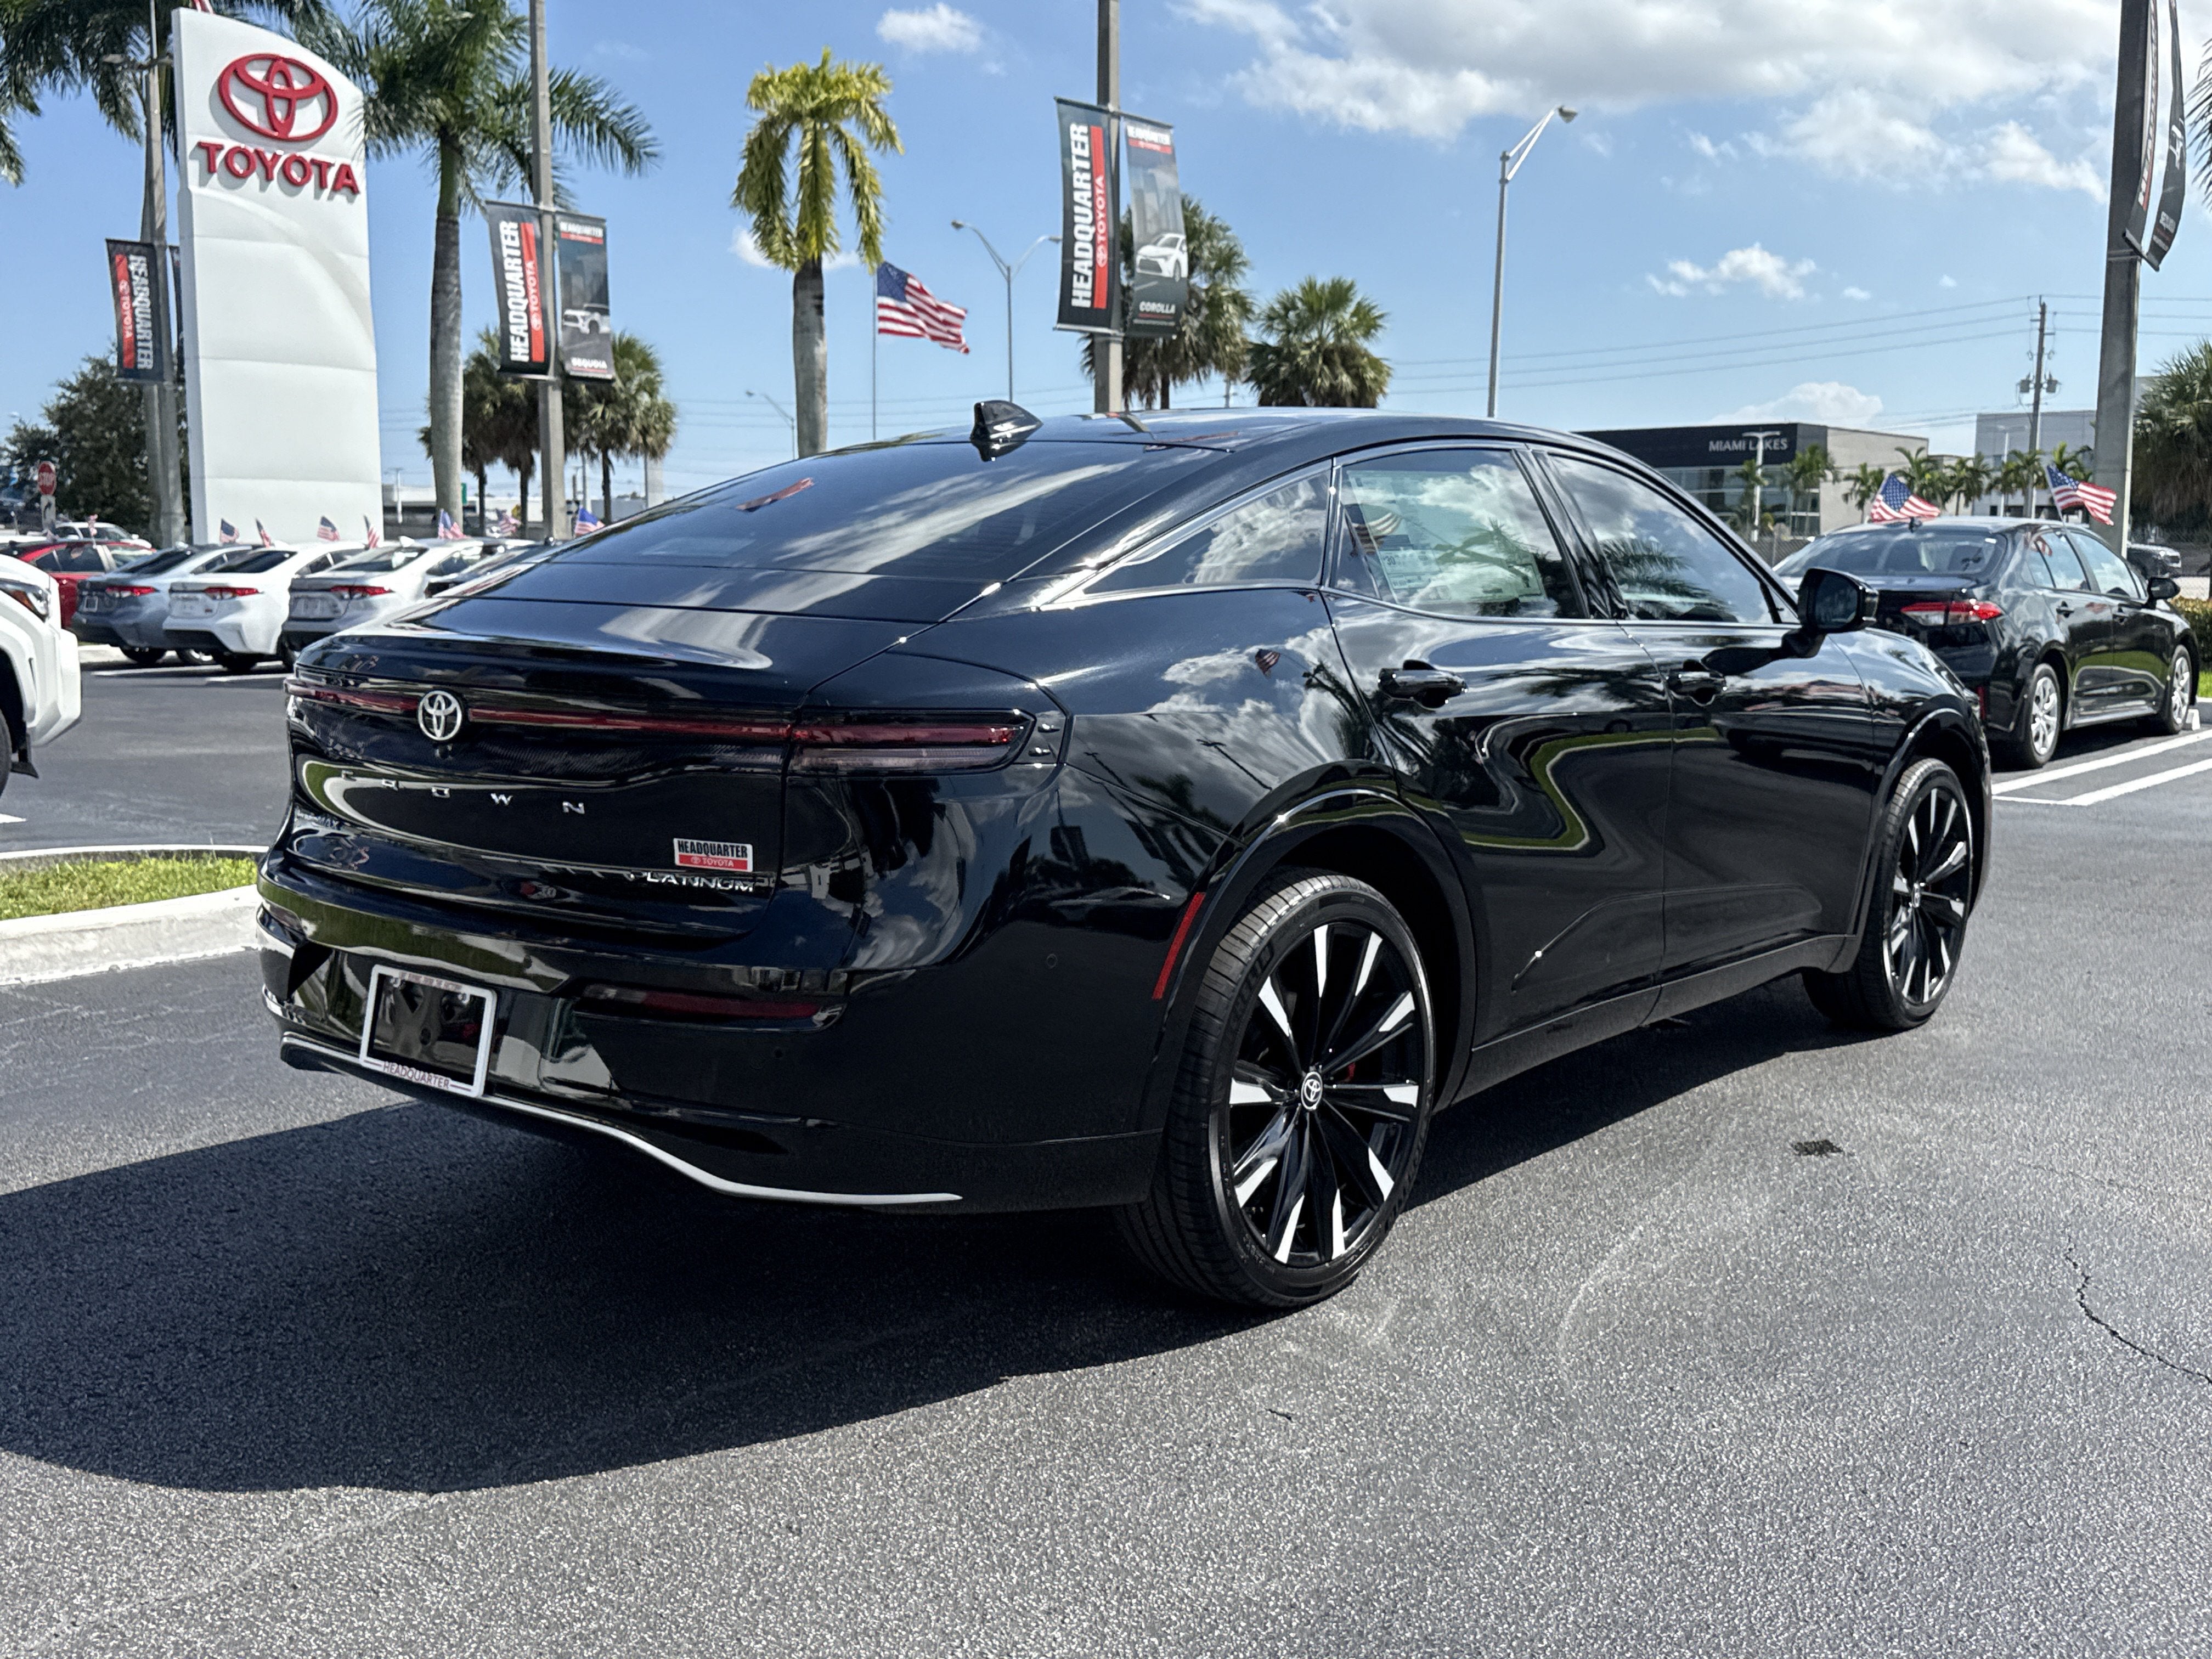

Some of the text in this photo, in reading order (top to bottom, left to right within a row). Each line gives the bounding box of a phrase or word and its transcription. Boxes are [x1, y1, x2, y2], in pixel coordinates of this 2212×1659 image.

[199, 142, 359, 194] TOYOTA
[1070, 123, 1096, 308] HEADQUARTER
[1094, 176, 1107, 242] TOYOTA
[499, 221, 529, 362] HEADQUARTER
[525, 261, 539, 313] TOYOTA
[1139, 301, 1176, 314] COROLLA
[120, 295, 133, 338] TOYOTA
[129, 255, 154, 369] HEADQUARTER
[1709, 438, 1788, 452] MIAMI LKES
[678, 840, 748, 857] HEADQUARTER
[703, 857, 734, 867] TOYOTA
[384, 1061, 451, 1089] HEADQUARTER
